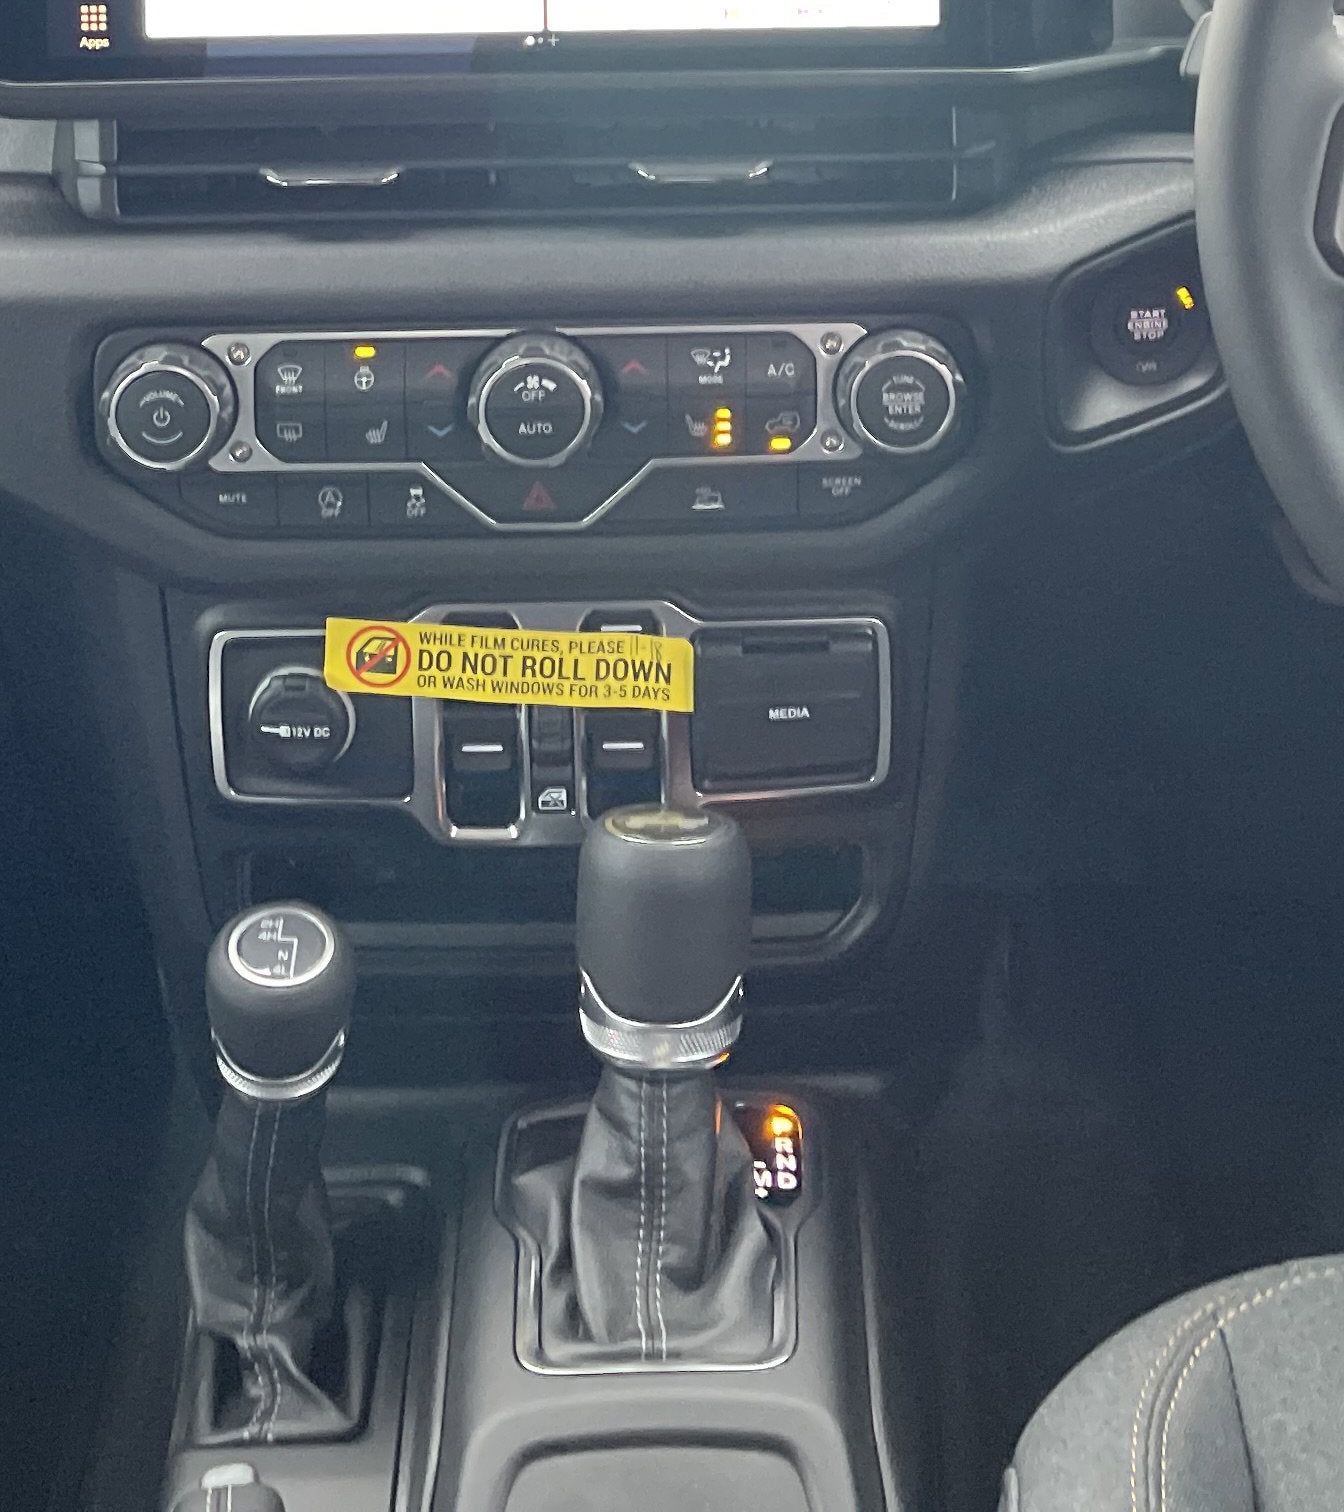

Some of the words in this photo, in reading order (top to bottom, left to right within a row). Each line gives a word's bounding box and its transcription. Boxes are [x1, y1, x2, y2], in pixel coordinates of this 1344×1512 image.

[79, 37, 110, 50] Apps
[1131, 309, 1166, 319] START
[1128, 319, 1168, 331] ENGINE
[1134, 330, 1164, 340] STOP
[767, 363, 795, 377] A/C
[275, 385, 303, 395] FRONT
[522, 390, 546, 402] OFF
[882, 392, 925, 405] BROWSE
[888, 405, 921, 415] ENTER
[518, 422, 553, 434] AUTO
[219, 494, 248, 504] MUTE
[419, 631, 466, 647] WHILE
[470, 635, 506, 650] FILM
[510, 637, 564, 655] CURES,
[569, 640, 625, 654] PLEASE
[418, 648, 452, 672] DO
[461, 651, 514, 677] NOT
[521, 655, 586, 681] ROLL
[595, 657, 672, 685] DOWN
[417, 674, 436, 688] OR
[442, 675, 486, 692] WASH
[490, 680, 564, 696] WINDOWS
[569, 683, 598, 697] FOR
[603, 684, 627, 698] 3-5
[632, 685, 670, 701] DAYS
[768, 707, 810, 720] MEDIA
[292, 727, 311, 738] 12V
[313, 727, 331, 738] DC
[258, 931, 276, 941] 4H
[277, 949, 288, 961] N
[775, 1137, 794, 1153] R
[776, 1153, 797, 1171] N
[754, 1169, 772, 1187] M
[777, 1172, 797, 1190] D
